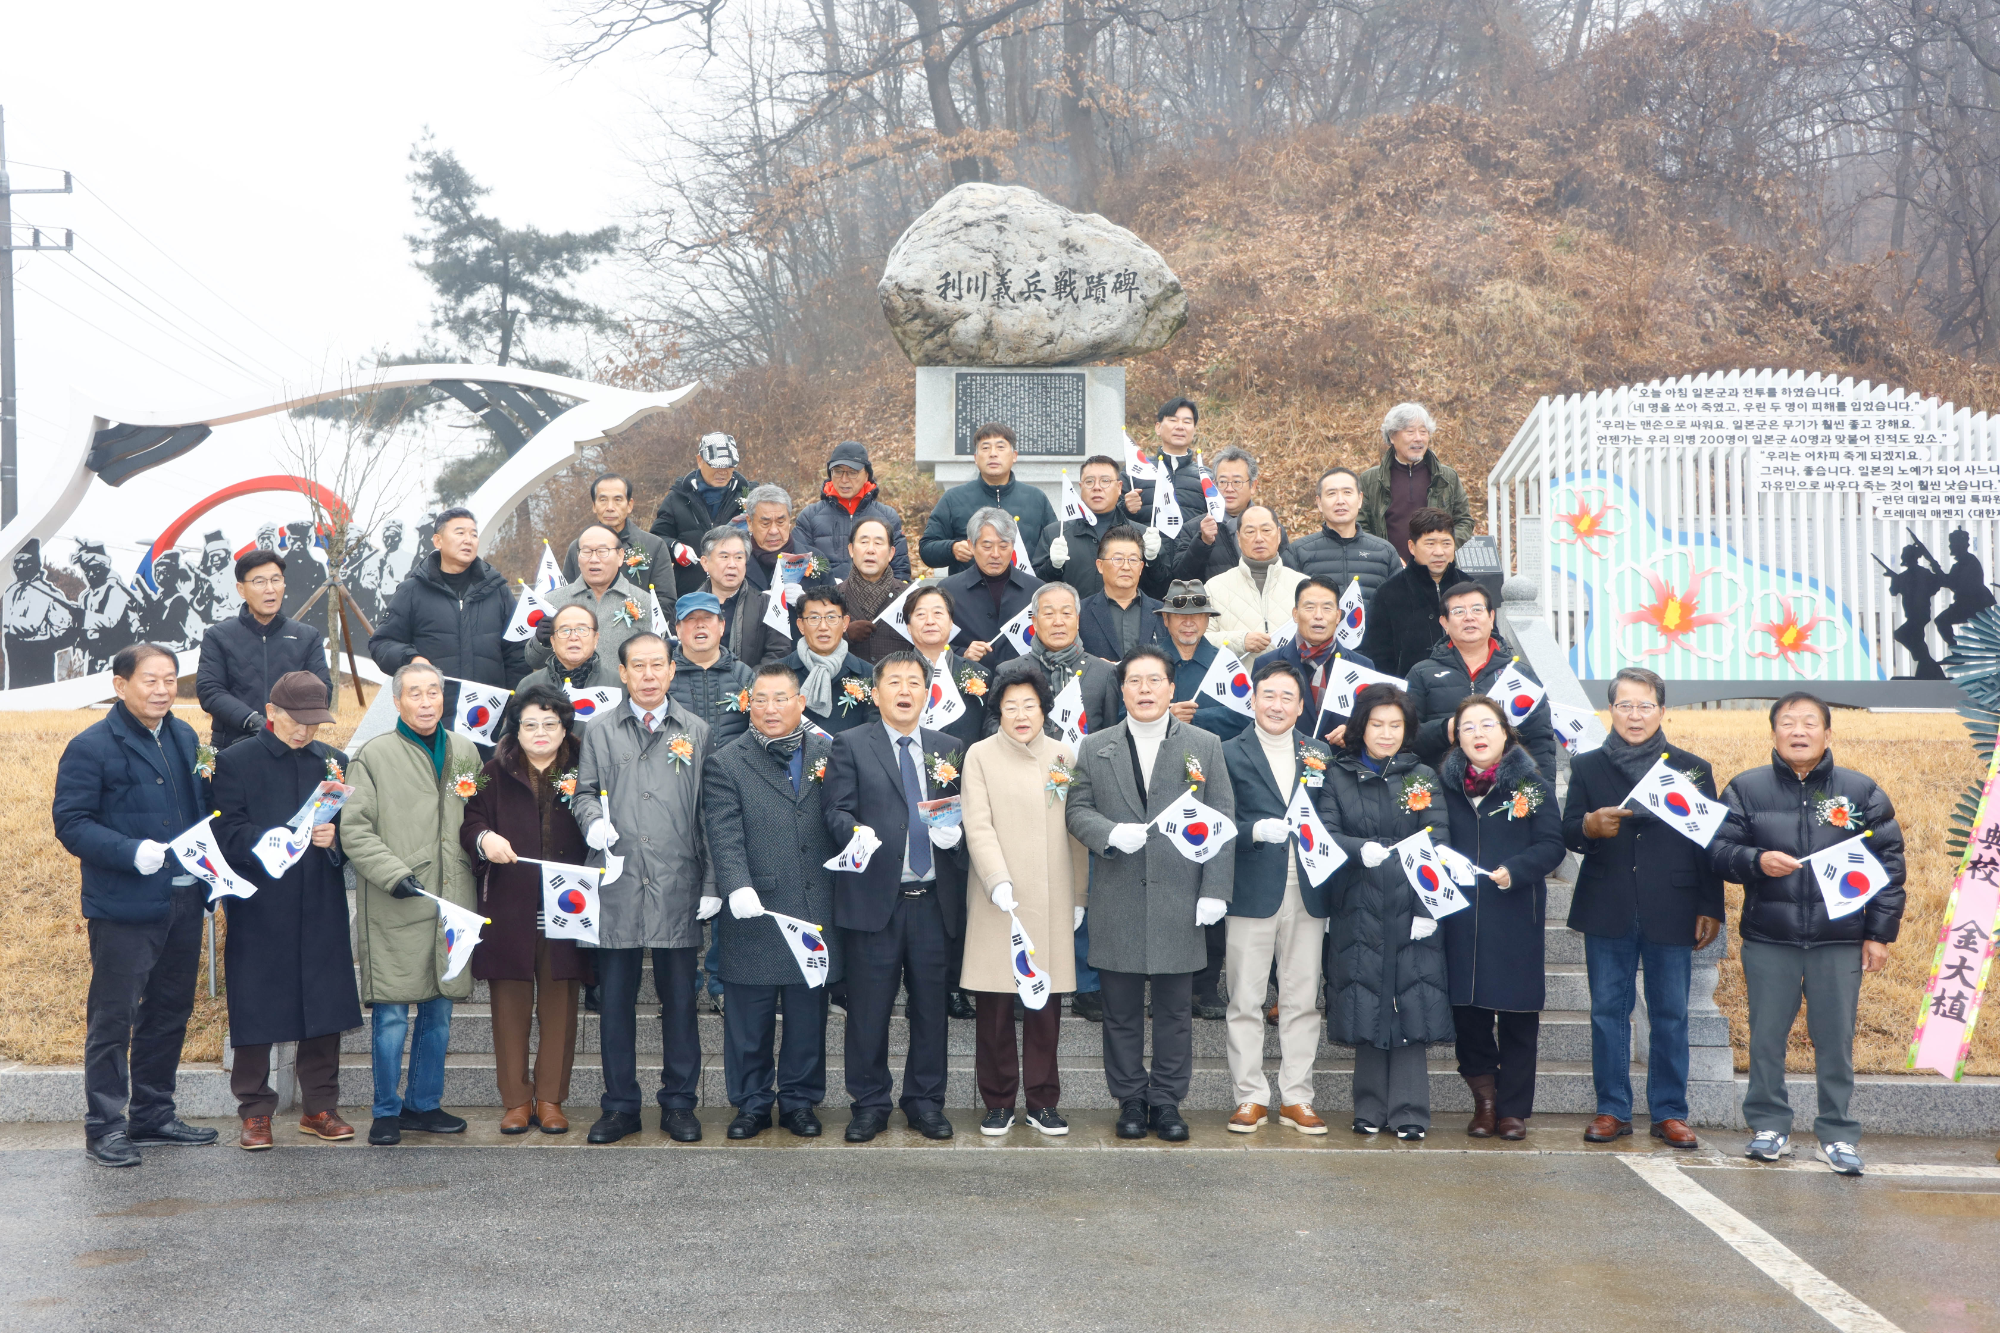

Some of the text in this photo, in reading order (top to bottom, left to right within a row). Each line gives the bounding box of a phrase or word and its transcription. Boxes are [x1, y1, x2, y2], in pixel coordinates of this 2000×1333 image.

[1664, 387, 1688, 399] 아침
[1691, 387, 1740, 399] 일본군과
[1742, 387, 1778, 398] 전투를
[1781, 386, 1845, 398] 하였습니다.
[1631, 401, 1645, 413] 네
[1647, 402, 1672, 414] 명을
[1674, 402, 1698, 413] 쏘아
[1700, 401, 1740, 413] 죽였고,
[1742, 401, 1766, 413] 우린
[1769, 402, 1782, 413] 두
[1784, 401, 1808, 413] 명이
[1811, 401, 1848, 413] 피해를
[1640, 419, 1687, 431] 맨손으로
[1690, 419, 1729, 431] 싸워요.
[1732, 419, 1780, 431] 일본군은
[1782, 419, 1819, 431] 무기가
[1821, 419, 1845, 431] 훨씬
[1847, 419, 1873, 431] 좋고
[1875, 418, 1916, 431] 강해요.
[1596, 434, 1644, 446] 언젠가는
[1646, 434, 1670, 445] 우리
[1673, 434, 1696, 446] 의병
[1699, 434, 1748, 446] 200명이
[1751, 434, 1788, 445] 일본군
[1790, 434, 1832, 446] 40명과
[1804, 450, 1840, 462] 어차피
[1843, 450, 1867, 462] 죽게
[1869, 450, 1922, 462] 되겠지요.
[1760, 465, 1800, 477] 그러나,
[1802, 465, 1855, 477] 좋습니다.
[1857, 465, 1894, 477] 일본의
[1896, 465, 1934, 477] 노예가
[1936, 464, 1961, 476] 되어
[1760, 480, 1821, 492] 자유민으로
[1823, 480, 1860, 492] 싸우다
[1862, 480, 1887, 491] 죽는
[1890, 480, 1914, 491] 것이
[1917, 479, 1942, 492] 훨씬
[1907, 494, 1941, 505] 데일리
[1944, 494, 1967, 505] 메일
[1882, 508, 1927, 519] 프레데릭
[1930, 508, 1964, 519] 매켄지
[1929, 919, 1989, 1024] 金大植
